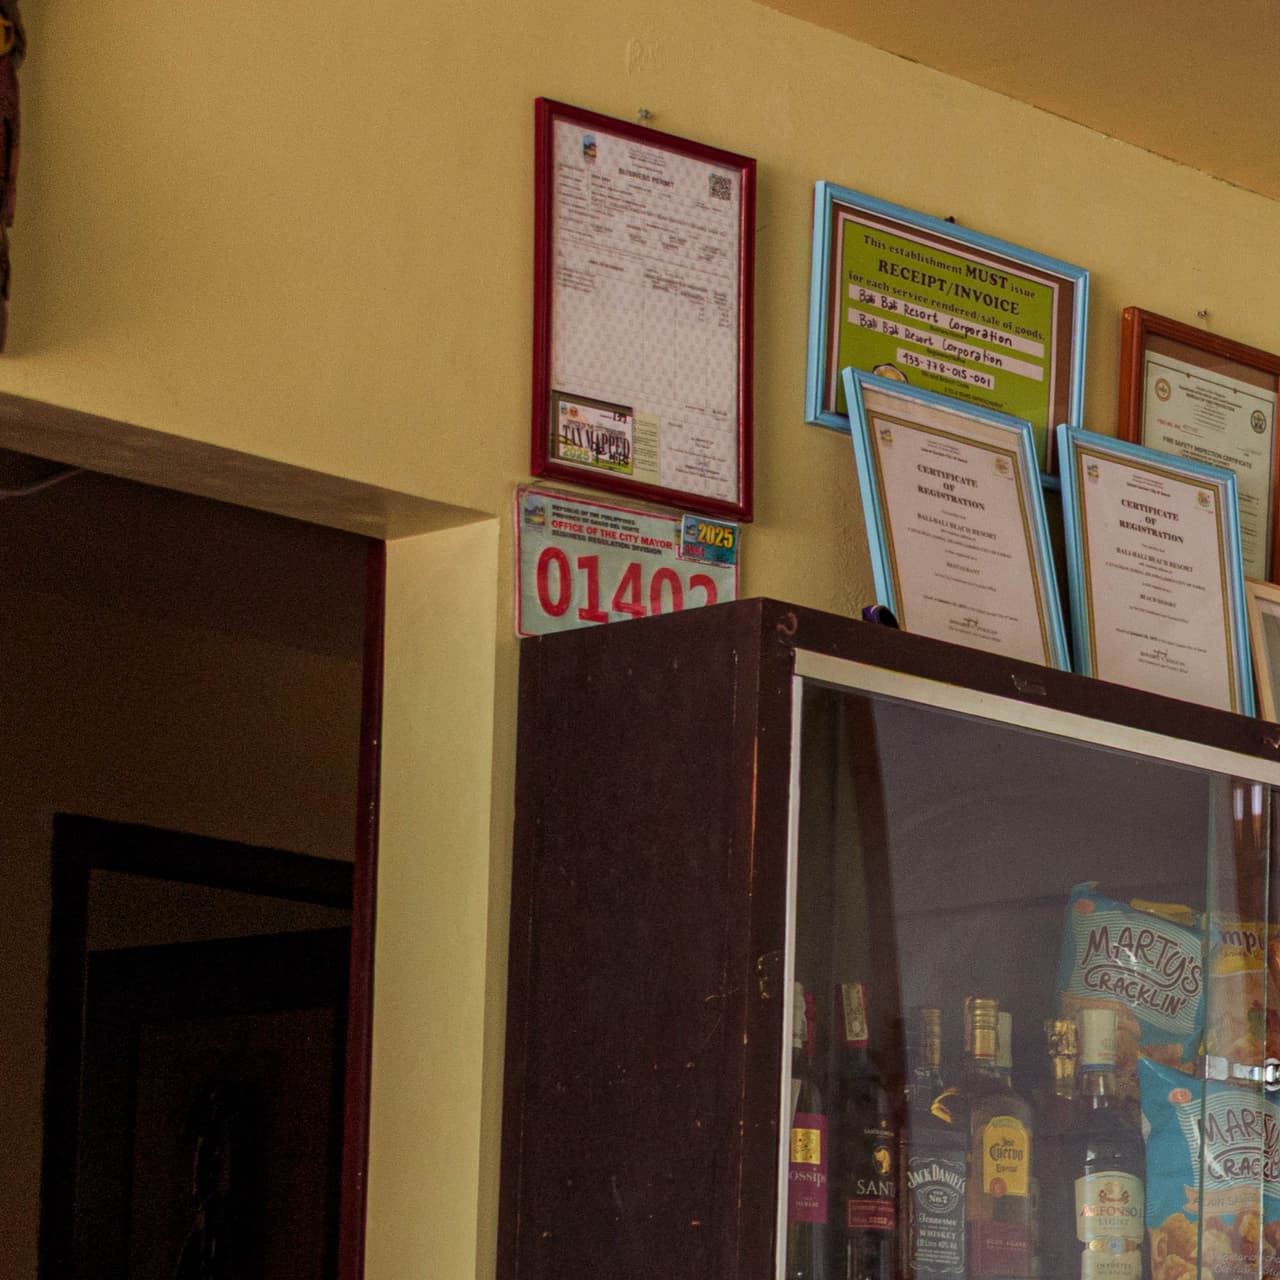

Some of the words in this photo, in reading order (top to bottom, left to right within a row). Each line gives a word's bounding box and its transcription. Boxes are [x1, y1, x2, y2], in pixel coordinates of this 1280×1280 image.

[863, 235, 887, 249] This
[889, 245, 963, 276] establishment
[965, 264, 1009, 290] MUST
[1010, 283, 1036, 299] issue
[848, 271, 864, 283] for
[866, 279, 890, 292] each
[892, 286, 929, 303] service
[1002, 321, 1013, 330] of
[878, 259, 1020, 316] RECEIPT/INVOICE
[904, 303, 939, 324] Resort
[949, 317, 1013, 347] Corporation
[904, 328, 935, 347] Resort
[942, 338, 1003, 367] Corporation
[916, 464, 978, 489] CERTIFICATE
[942, 482, 956, 492] OF
[917, 485, 985, 511] REGISTRATION
[1121, 499, 1179, 522] CERTIFICATE
[551, 520, 583, 534] OFFICE
[586, 526, 598, 536] OF
[600, 529, 618, 540] THE
[619, 532, 638, 544] CITY
[641, 537, 673, 549] MAYOR
[1119, 520, 1184, 544] REGISTRATION
[1144, 517, 1157, 526] OF
[697, 522, 733, 548] 2025
[1081, 925, 1201, 996] MARTY'S
[1083, 967, 1188, 1017] CRACKLIN'
[907, 1168, 930, 1189] JACK
[1080, 1203, 1137, 1217] ALFONSO
